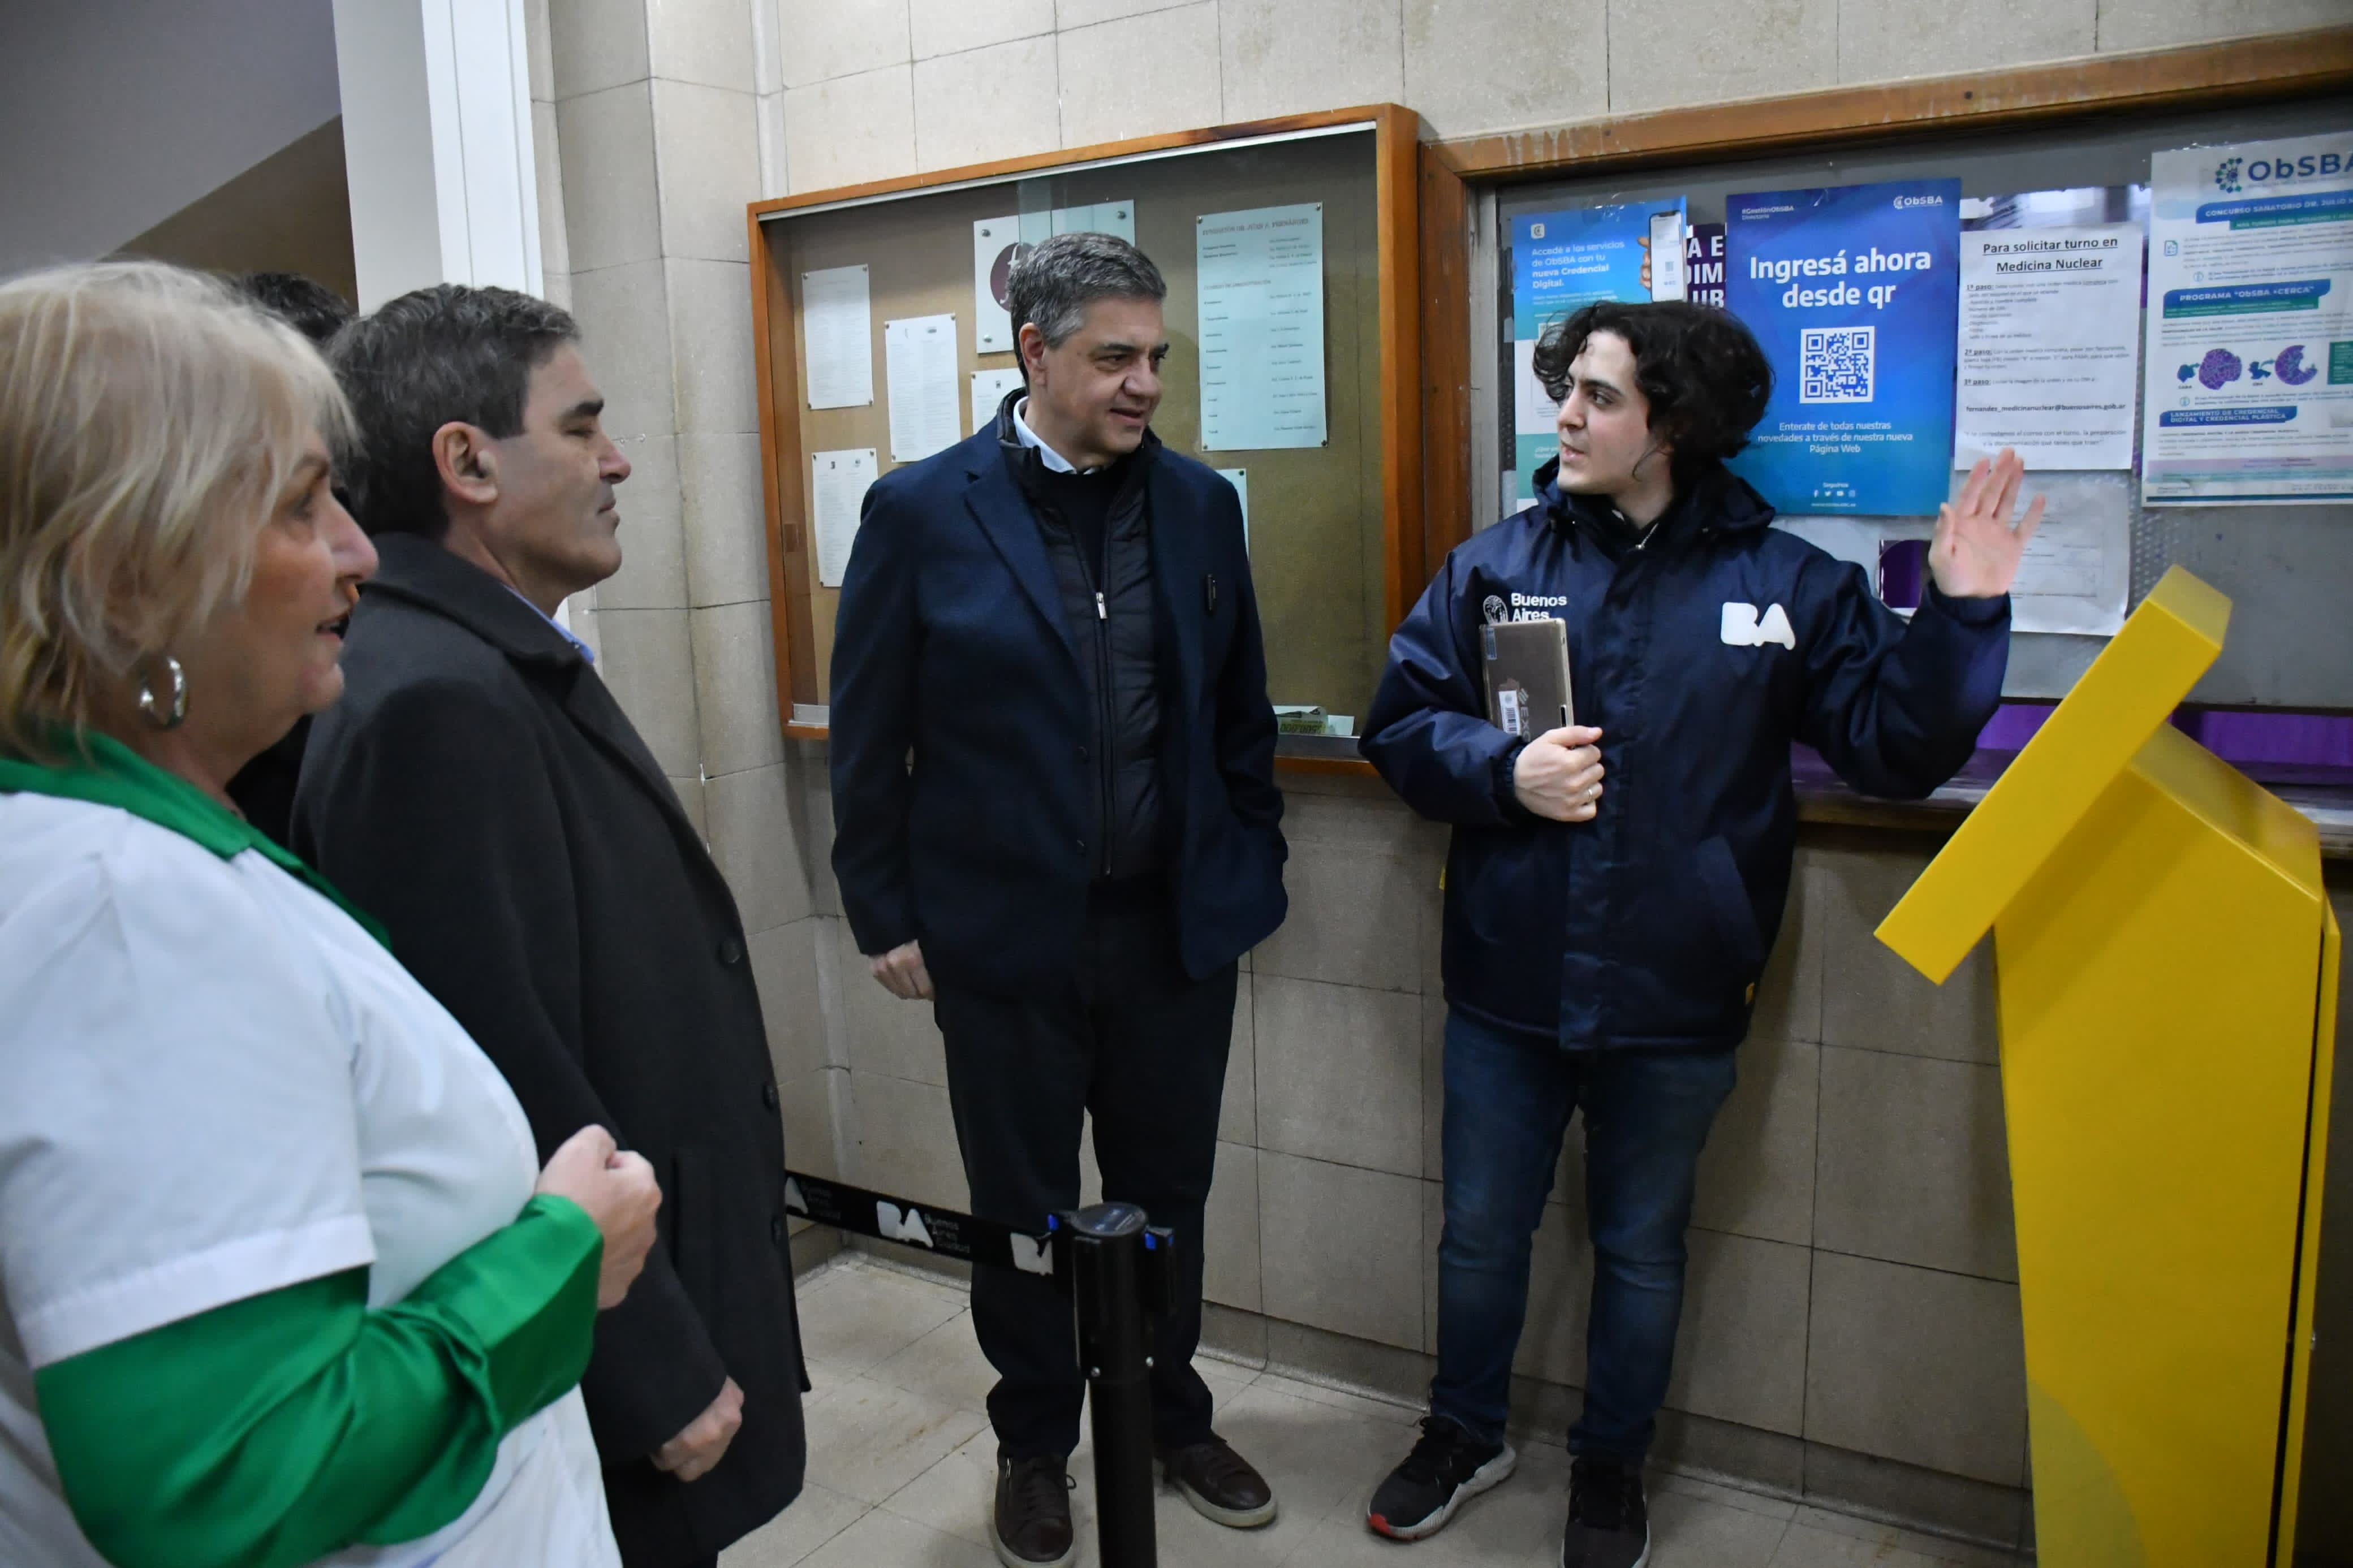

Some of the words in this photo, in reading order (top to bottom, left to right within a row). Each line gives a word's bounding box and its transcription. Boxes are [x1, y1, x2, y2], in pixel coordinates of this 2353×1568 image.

[1904, 196, 1943, 205] ObSBA
[1572, 243, 1585, 253] los
[1587, 240, 1626, 252] servicios
[1687, 241, 1702, 258] A
[1711, 235, 1724, 257] E
[1983, 244, 2010, 253] Para
[2013, 240, 2062, 252] solicitar
[2064, 238, 2099, 249] turno
[2102, 237, 2119, 247] en
[1532, 258, 1543, 267] de
[1596, 253, 1606, 262] tu
[1750, 249, 1847, 283] Ingresá
[1854, 247, 1931, 273] ahora
[1996, 261, 2052, 272] Medicina
[2055, 258, 2103, 269] Nuclear
[1532, 268, 1559, 278] nueva
[1561, 264, 1610, 276] Credencial
[1532, 279, 1565, 290] Digital.
[1782, 282, 1860, 308] desde
[1868, 284, 1896, 309] qr
[2180, 291, 2231, 301] PROGRAMA
[1779, 422, 1815, 431] Enterate
[1817, 422, 1828, 430] de
[1830, 421, 1854, 430] todas
[1758, 433, 1803, 443] novedades
[1812, 433, 1839, 442] través
[1841, 433, 1851, 442] de
[1809, 444, 1839, 455] Página
[1841, 444, 1860, 453] Web
[1511, 593, 1567, 607] Buenos
[1512, 608, 1550, 620] Aires
